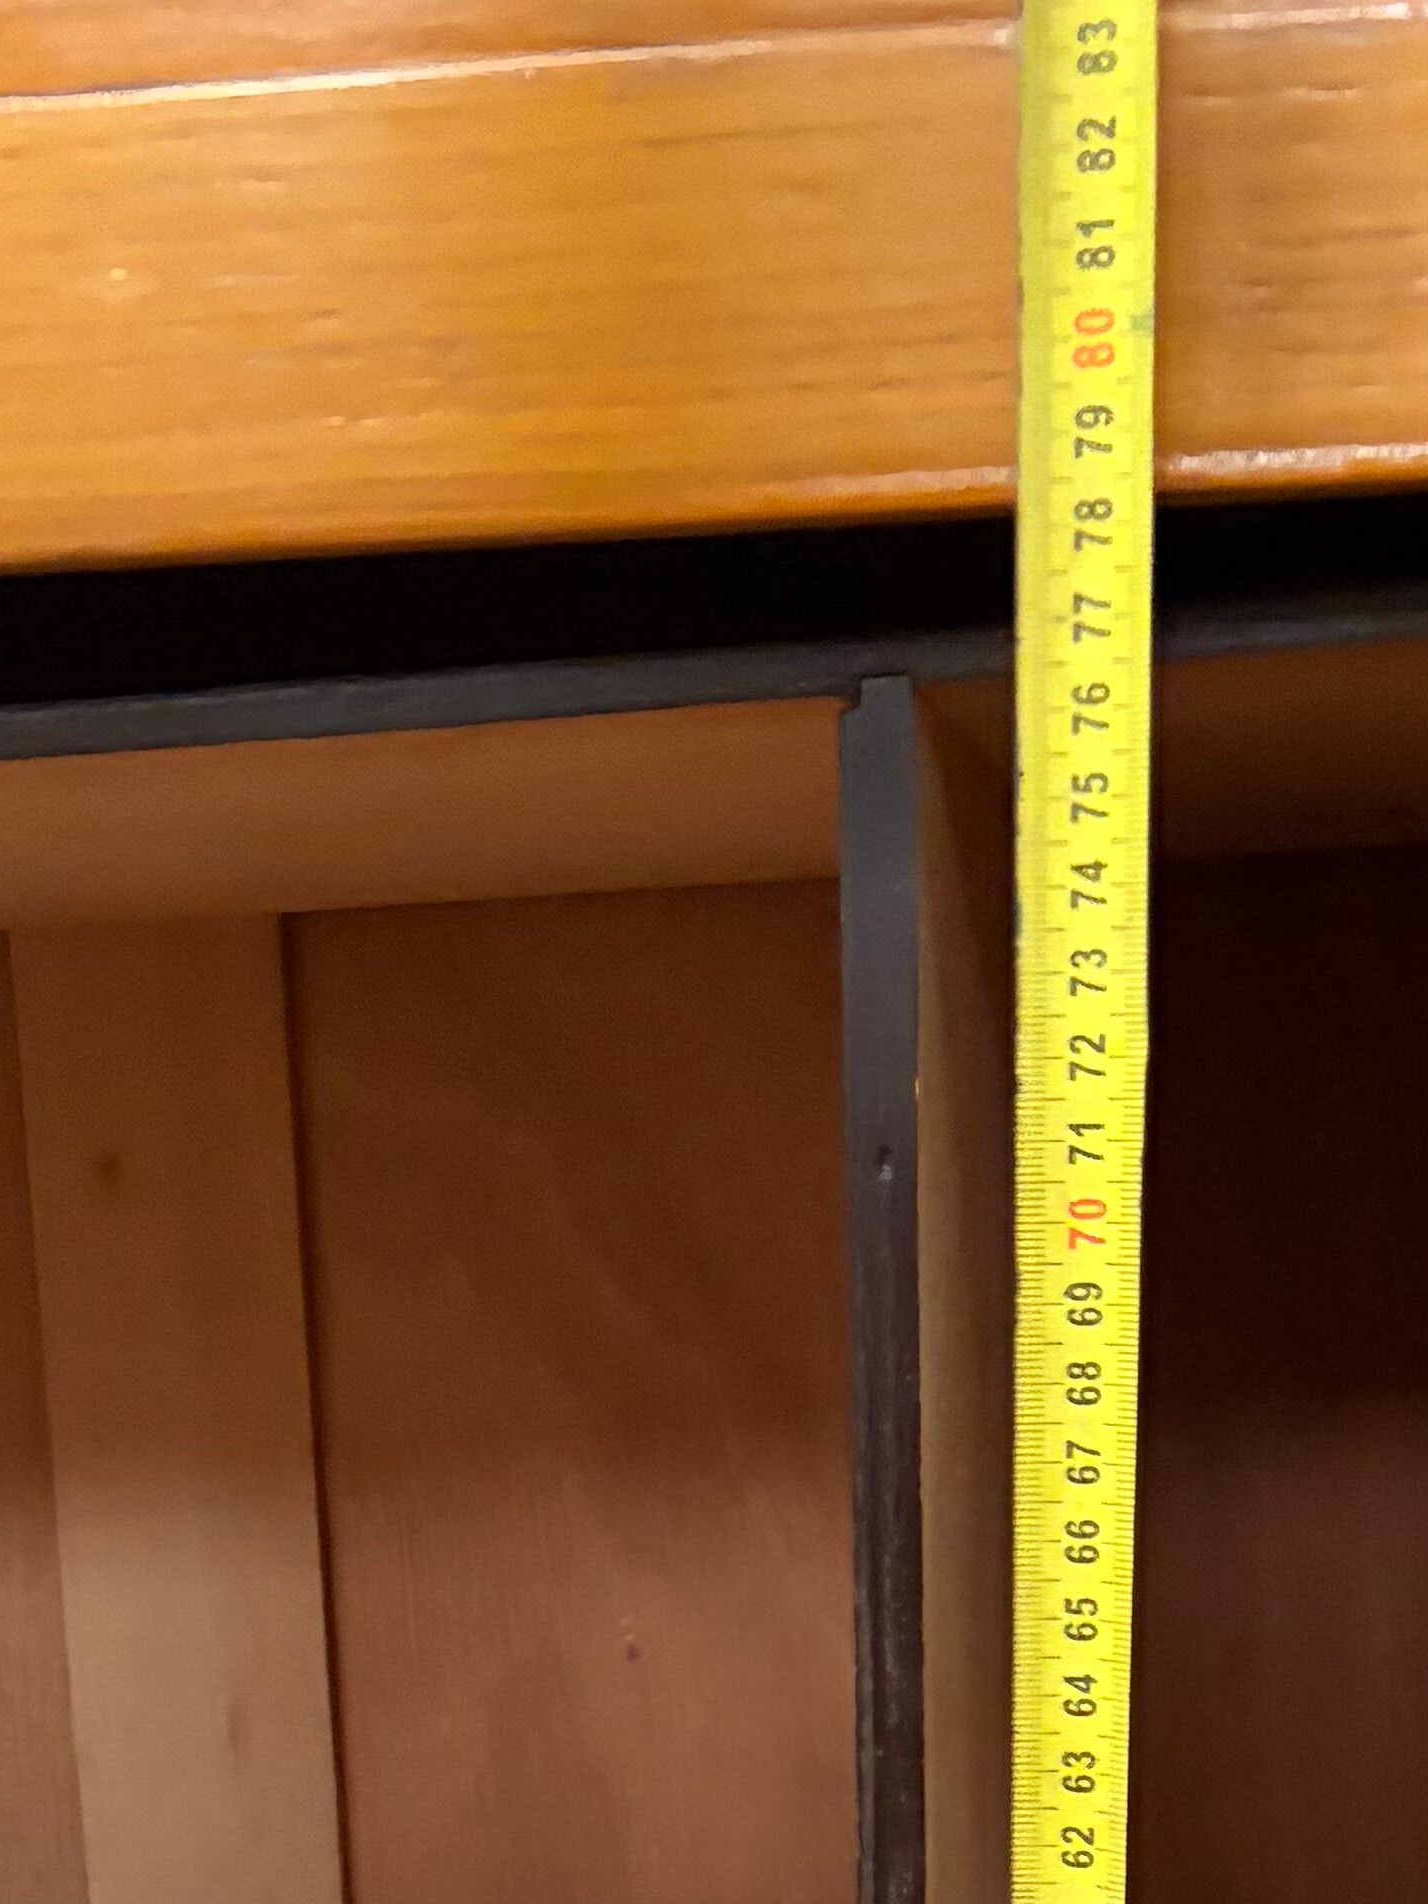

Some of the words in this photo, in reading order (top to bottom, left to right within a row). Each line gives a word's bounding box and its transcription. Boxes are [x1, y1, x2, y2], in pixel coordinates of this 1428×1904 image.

[1076, 20, 1117, 75] 83
[1076, 117, 1116, 173] 82
[1076, 220, 1115, 269] 81
[1072, 309, 1115, 369] 80
[1074, 405, 1113, 459] 79
[1073, 499, 1112, 552] 78
[1072, 592, 1111, 643] 77
[1071, 683, 1110, 735] 76
[1070, 773, 1108, 823] 75
[1070, 861, 1107, 909] 74
[1070, 949, 1107, 996] 73
[1069, 1034, 1105, 1081] 72
[1068, 1124, 1104, 1164] 71
[1068, 1199, 1106, 1250] 70
[1064, 1283, 1102, 1326] 69
[1066, 1362, 1101, 1405] 68
[1066, 1440, 1100, 1484] 67
[1065, 1520, 1099, 1564] 66
[1064, 1598, 1098, 1641] 65
[1063, 1675, 1097, 1716] 64
[1062, 1752, 1096, 1793] 63
[1061, 1827, 1094, 1868] 62
